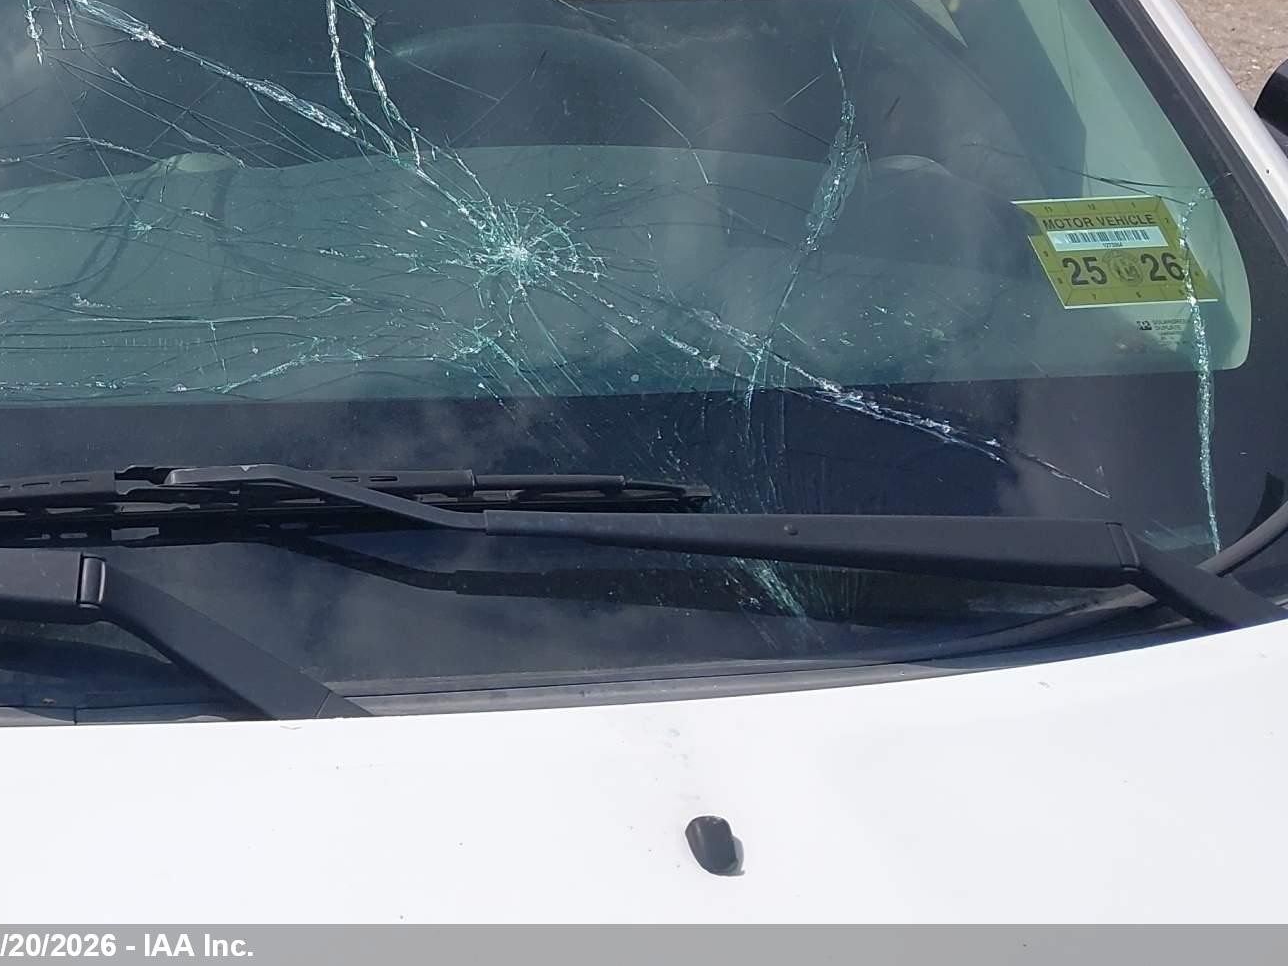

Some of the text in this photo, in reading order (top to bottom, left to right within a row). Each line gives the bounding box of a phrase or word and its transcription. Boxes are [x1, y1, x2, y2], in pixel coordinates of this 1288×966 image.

[1042, 216, 1095, 230] MOTOR
[1095, 213, 1157, 226] VEHICLE
[1061, 255, 1108, 286] 25
[1140, 252, 1186, 282] 26
